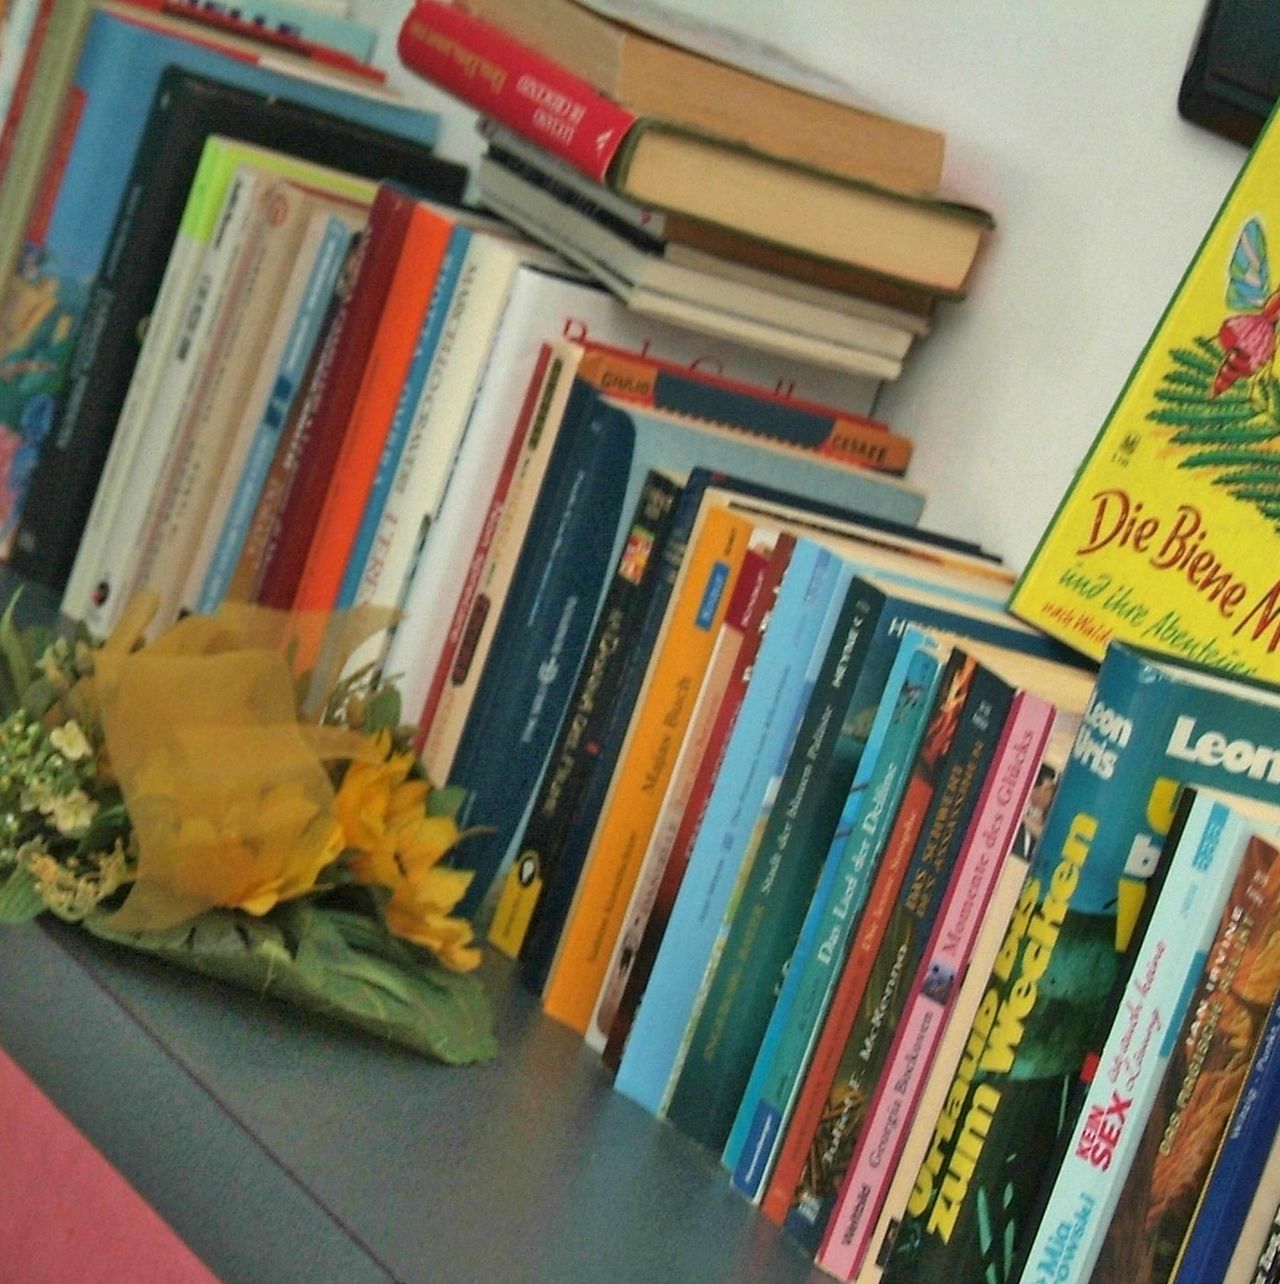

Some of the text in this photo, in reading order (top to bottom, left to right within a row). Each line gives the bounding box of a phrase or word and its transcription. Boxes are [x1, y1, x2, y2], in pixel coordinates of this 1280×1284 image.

[1077, 489, 1151, 554] Die
[1149, 503, 1248, 614] Biene
[1103, 586, 1149, 626] ihre
[816, 923, 842, 963] Das
[848, 838, 872, 872] der
[867, 1099, 904, 1169] Georgia
[941, 853, 990, 956] Momente
[979, 809, 1006, 849] des
[993, 726, 1036, 807] Glücks
[922, 811, 1101, 1241] zum Wecken
[1158, 915, 1256, 1155] DAS MAGISCHE RELIKT
[1183, 904, 1244, 1045] IAN IRVINE
[1075, 1105, 1106, 1159] KEIN
[1088, 1092, 1132, 1170] SEX
[1036, 1220, 1072, 1275] Mia
